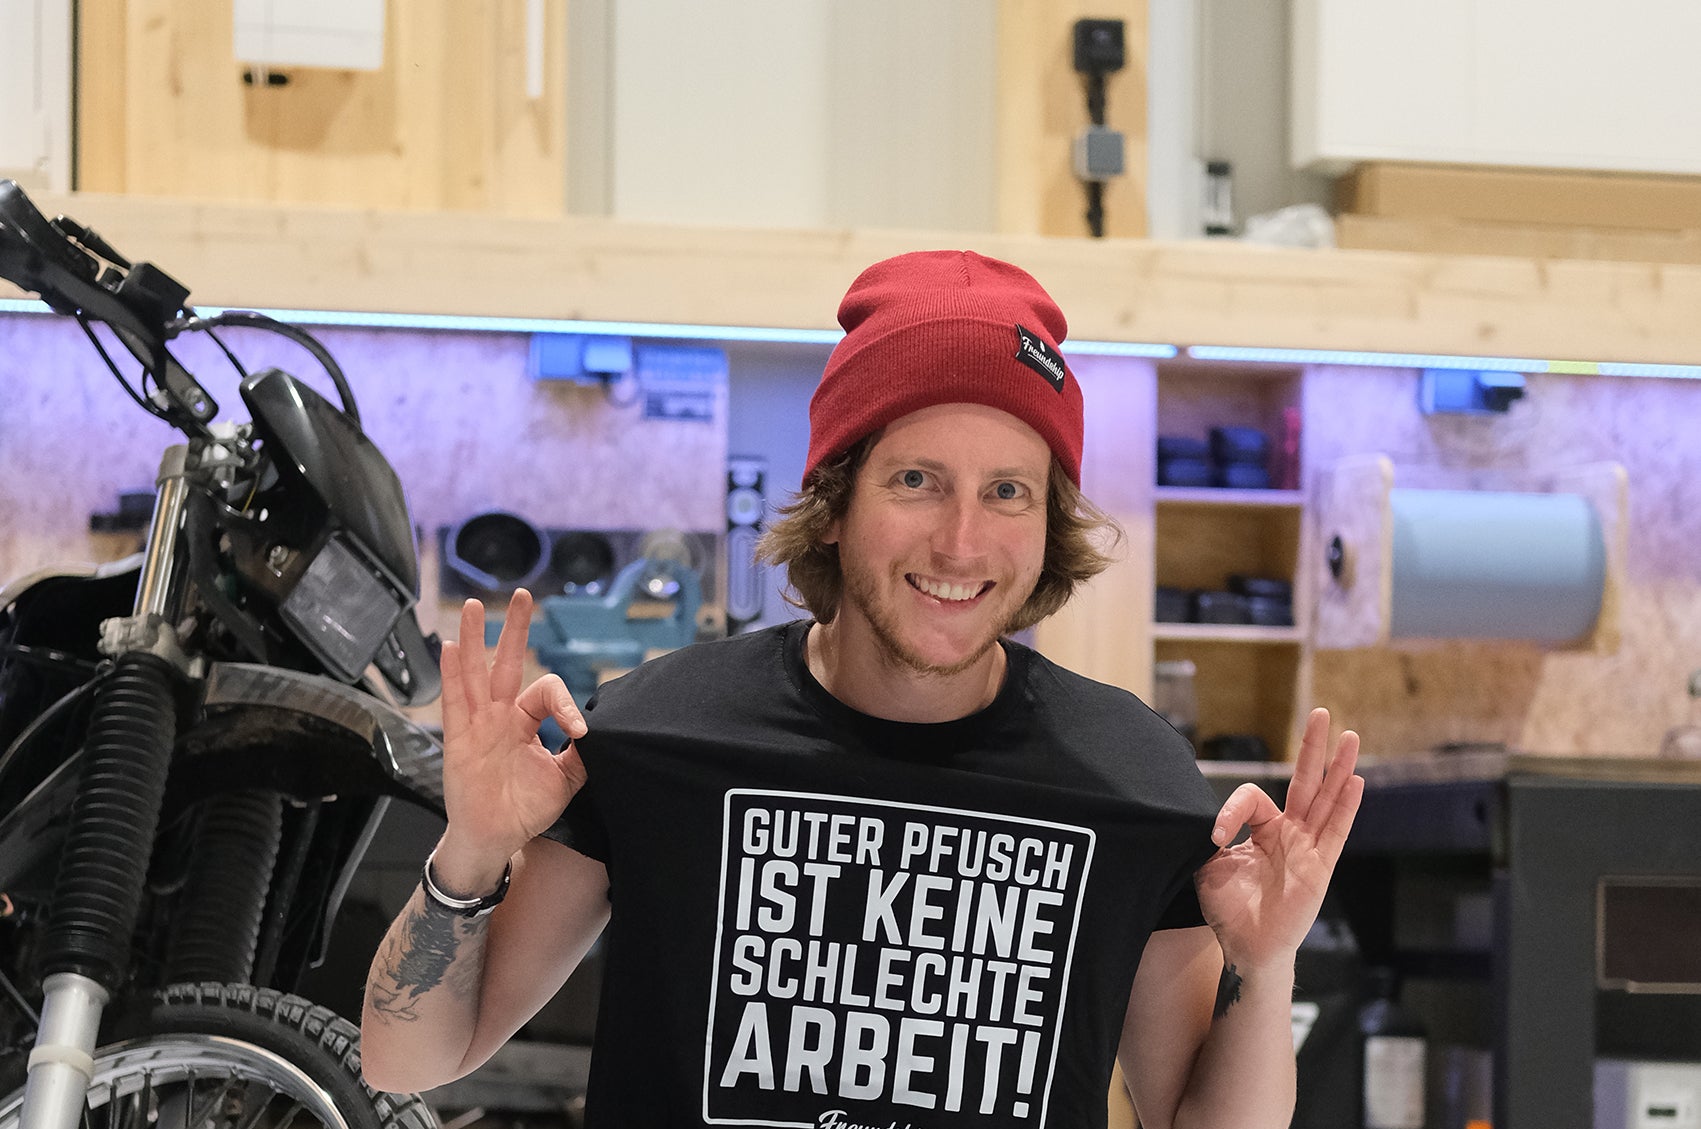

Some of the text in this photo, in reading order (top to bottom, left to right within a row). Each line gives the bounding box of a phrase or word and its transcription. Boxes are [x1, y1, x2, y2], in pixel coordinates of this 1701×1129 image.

[1022, 335, 1065, 381] Freundship
[743, 807, 1074, 891] GUTER PFUSCH
[735, 856, 1065, 964] IST KEINE
[730, 934, 1052, 1028] SCHLECHTE
[719, 1001, 1042, 1119] ARBEIT!
